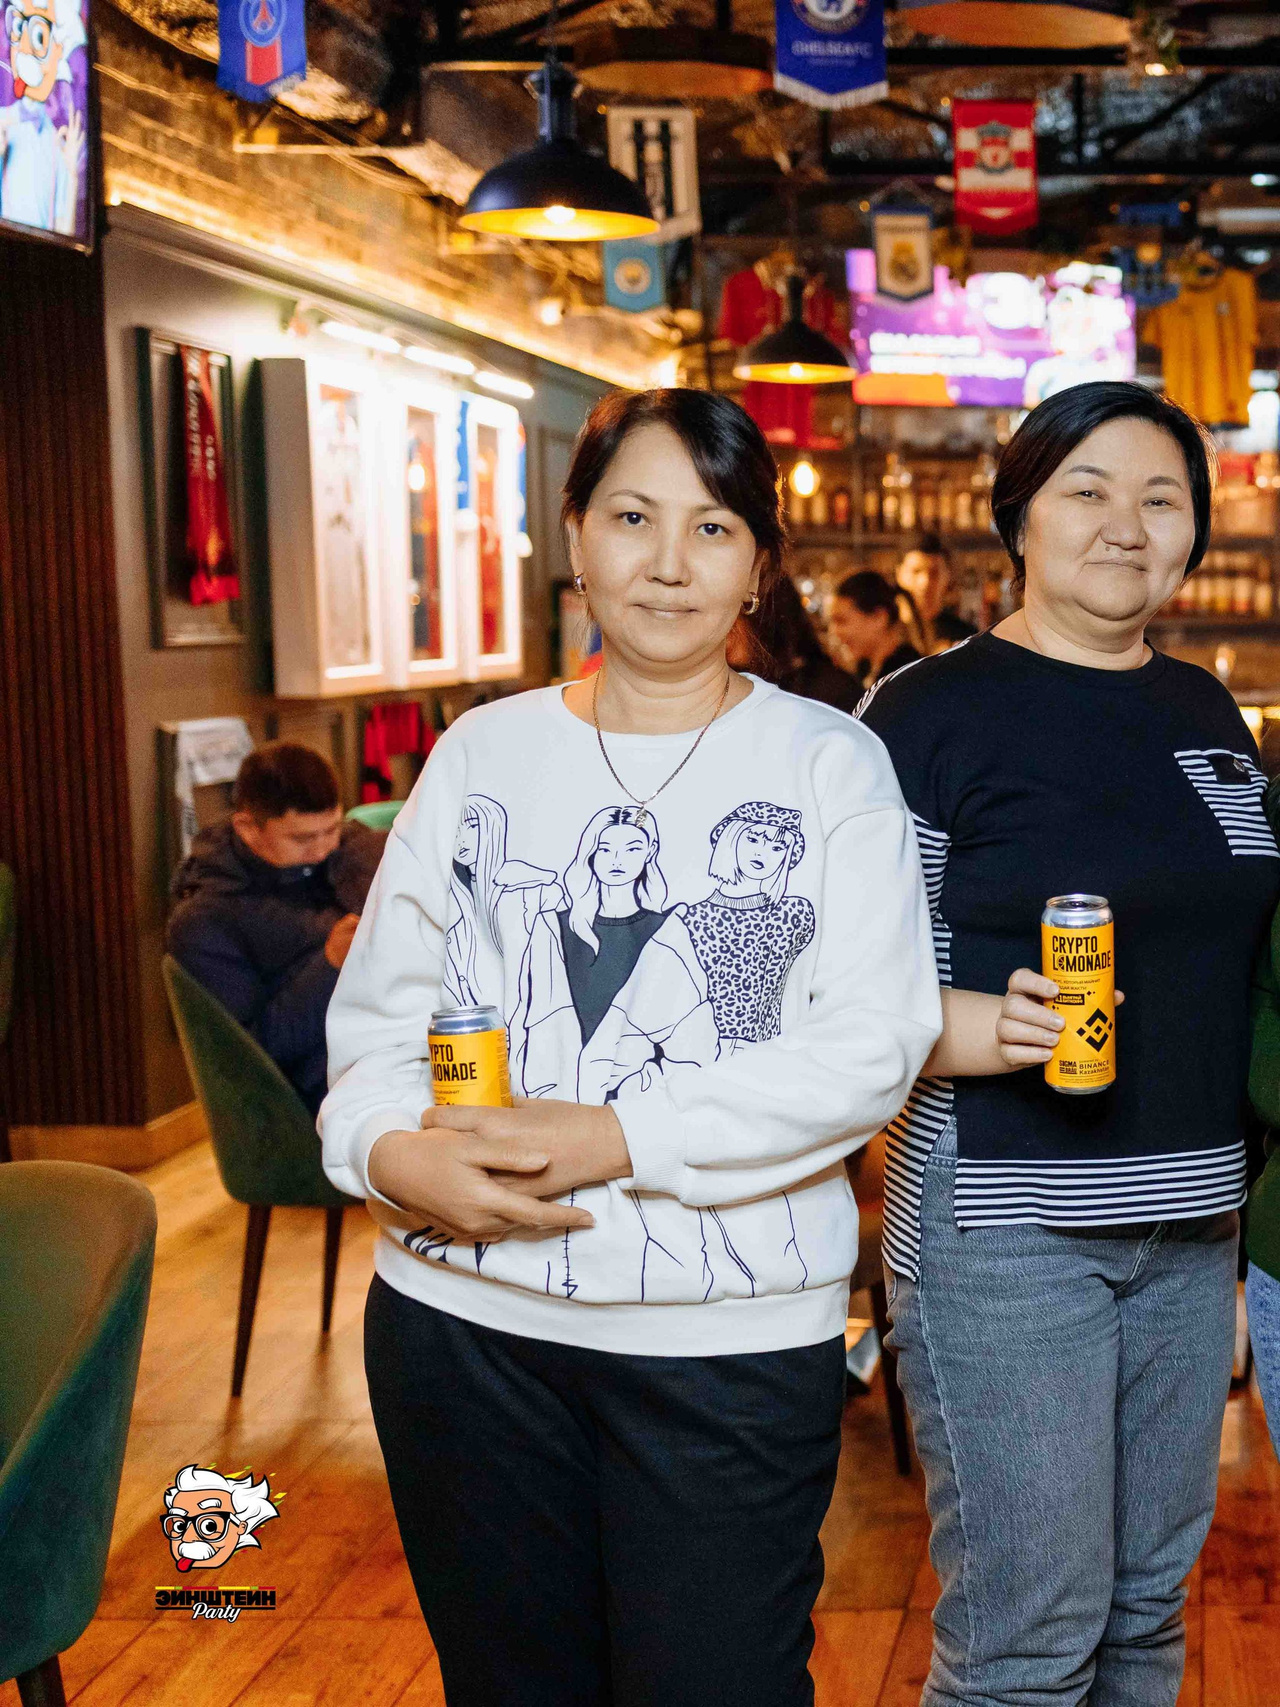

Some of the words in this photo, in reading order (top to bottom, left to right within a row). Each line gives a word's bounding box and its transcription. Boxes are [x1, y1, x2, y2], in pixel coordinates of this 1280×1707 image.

[1052, 935, 1098, 954] CRYPTO
[429, 1043, 454, 1062] YPTO
[433, 1061, 477, 1082] ONADE
[1079, 1059, 1110, 1070] BINANCE
